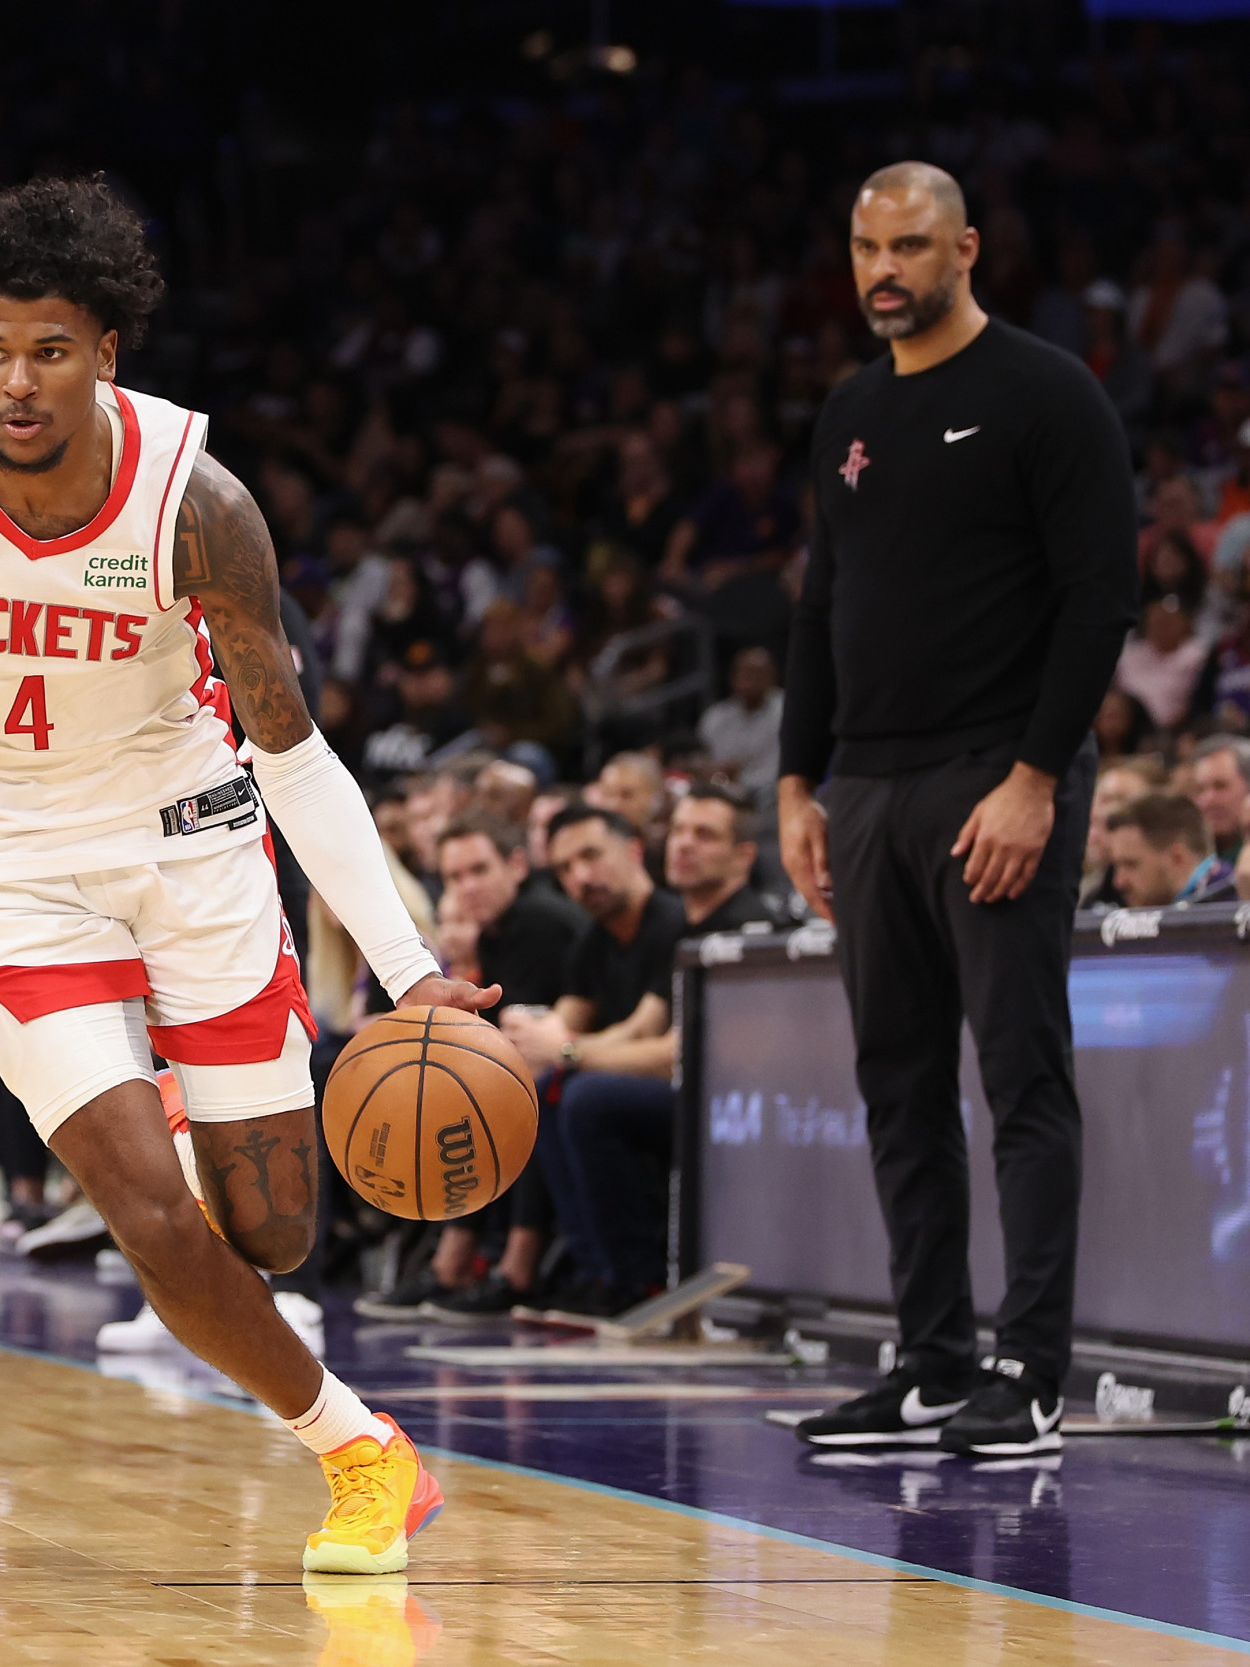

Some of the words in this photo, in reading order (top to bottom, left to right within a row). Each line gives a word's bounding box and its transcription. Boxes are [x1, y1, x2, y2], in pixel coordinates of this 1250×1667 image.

[83, 570, 147, 589] karma
[88, 554, 149, 572] credit
[4, 674, 55, 751] 4
[436, 1116, 479, 1214] Wilso
